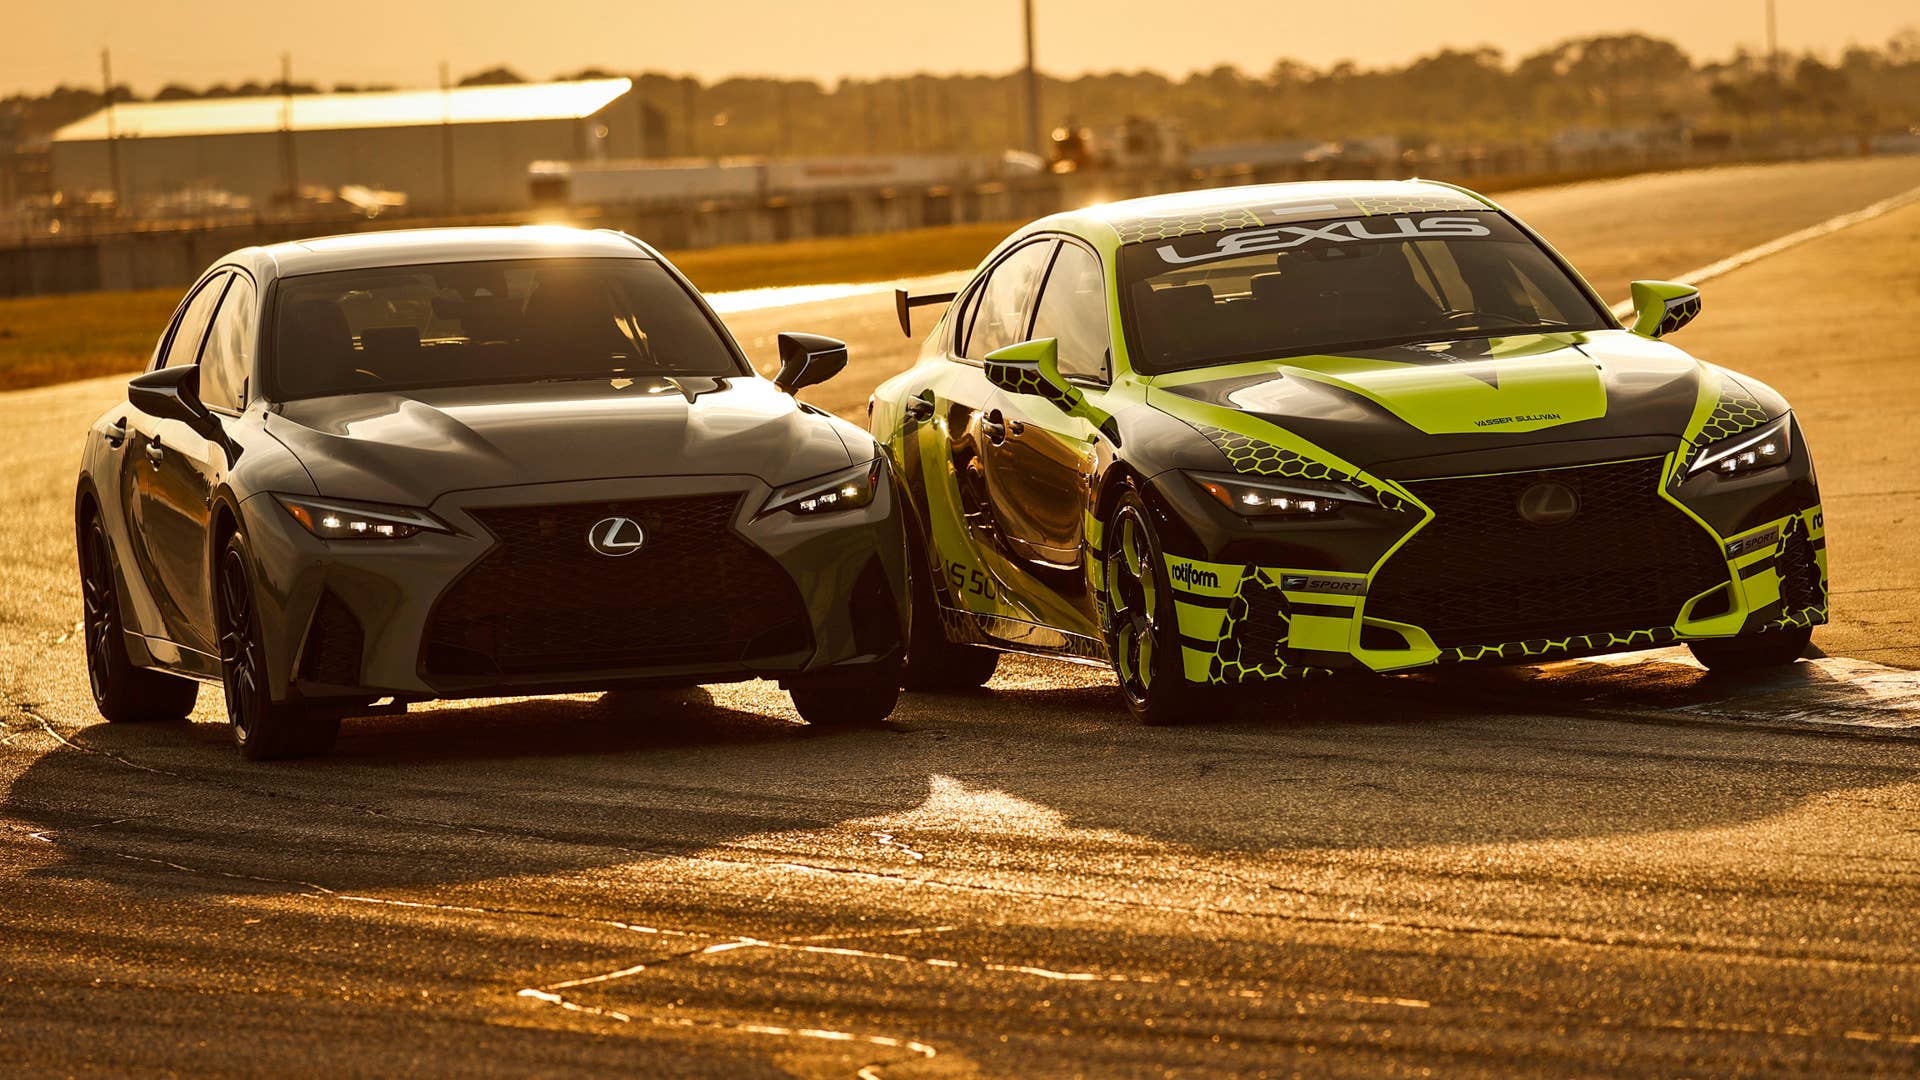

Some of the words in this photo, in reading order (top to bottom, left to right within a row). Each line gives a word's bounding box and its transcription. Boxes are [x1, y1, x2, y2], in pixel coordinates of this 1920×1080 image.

[1156, 216, 1491, 264] LEXUS
[1473, 416, 1514, 427] VASSER
[1515, 413, 1561, 423] SULLIVAN
[1745, 531, 1777, 550] SPORT
[1171, 562, 1220, 591] rotiform
[1310, 580, 1362, 591] SPORT
